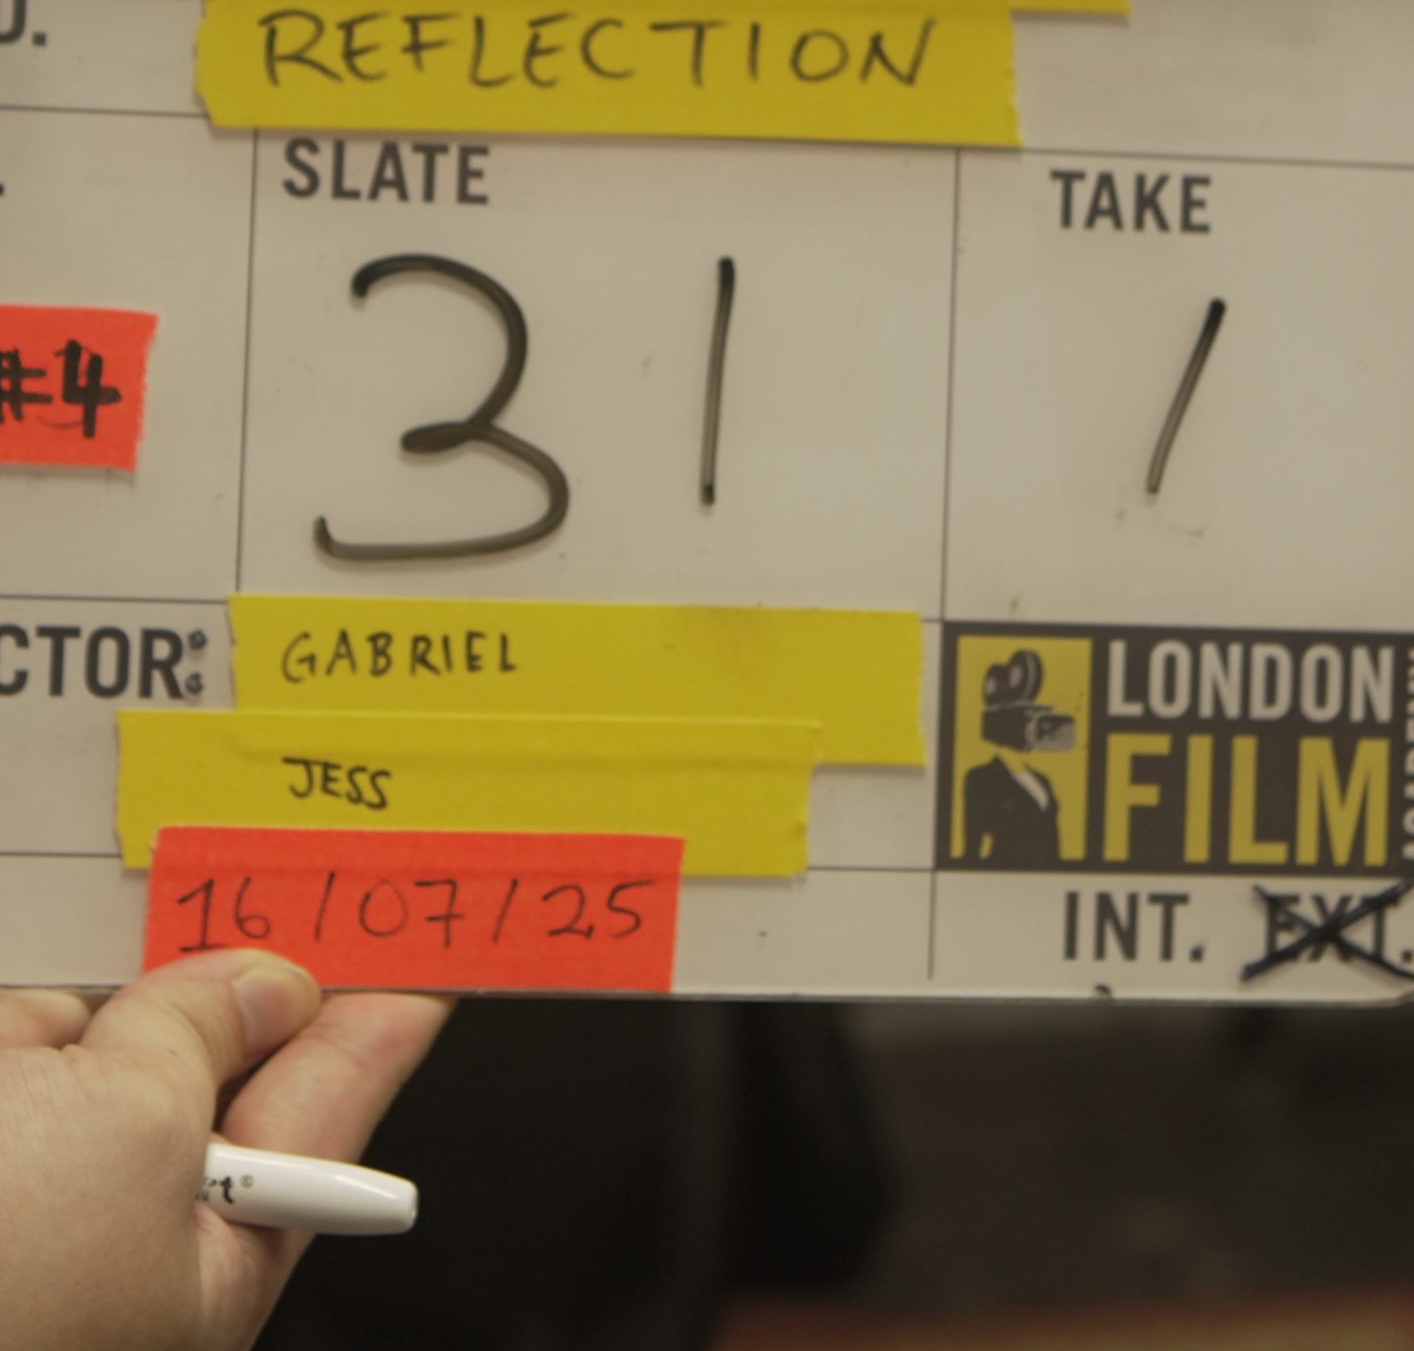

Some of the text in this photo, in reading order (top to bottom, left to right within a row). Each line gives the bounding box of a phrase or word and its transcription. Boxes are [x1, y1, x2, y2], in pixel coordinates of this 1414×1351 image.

[258, 9, 937, 87] REFLECTION
[282, 139, 491, 205] SLATE
[1050, 170, 1213, 233] TAKE
[280, 629, 518, 683] GABRIEL
[1105, 639, 1395, 723] LONDON
[280, 756, 392, 811] JESS
[1102, 732, 1391, 866] FILM
[1063, 890, 1207, 962] INT.
